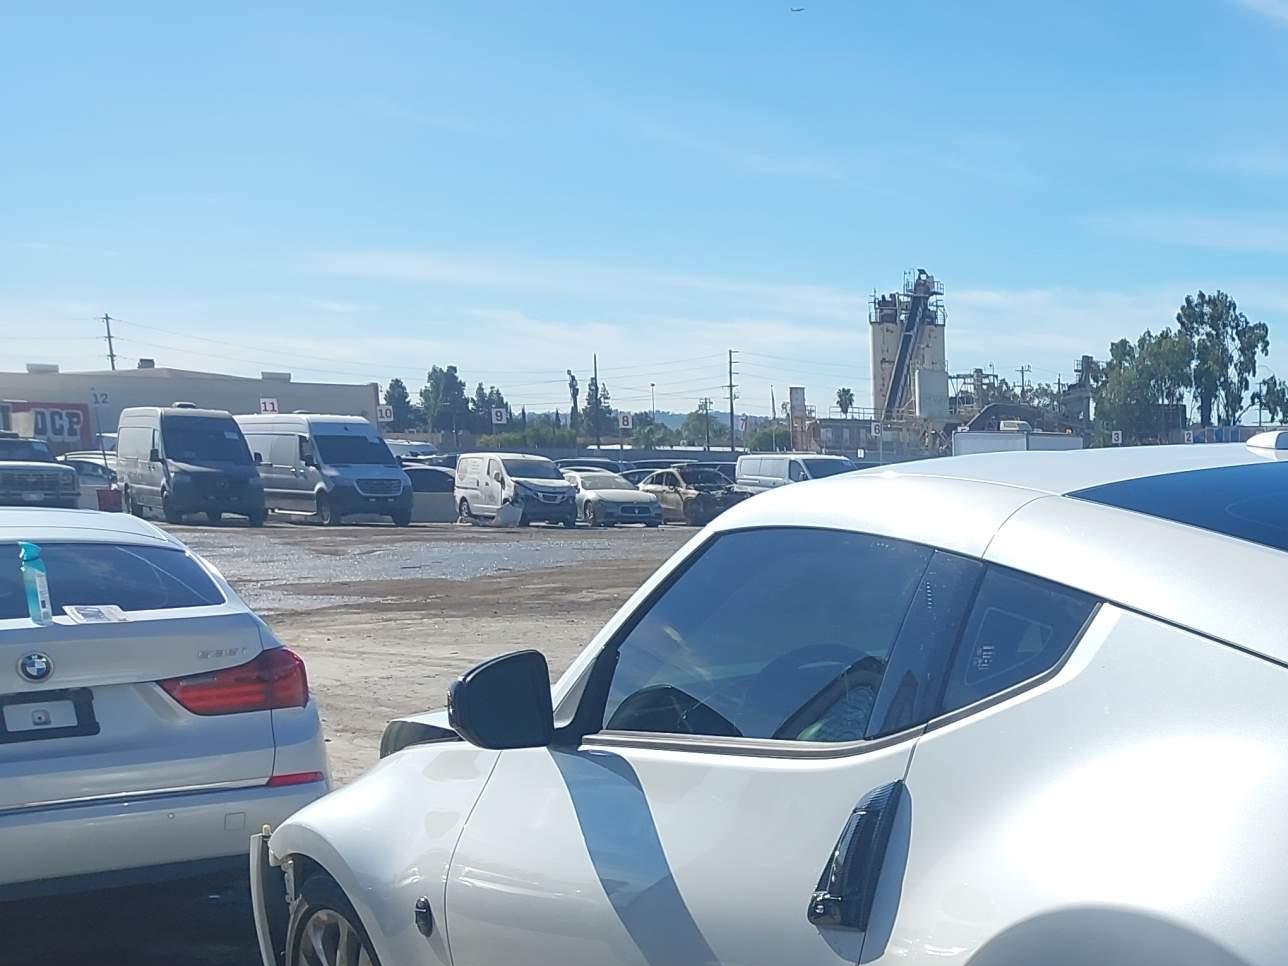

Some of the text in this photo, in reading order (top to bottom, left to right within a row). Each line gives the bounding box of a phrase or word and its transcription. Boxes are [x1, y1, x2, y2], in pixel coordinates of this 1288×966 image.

[93, 393, 109, 404] 12
[261, 401, 278, 413] 11
[378, 408, 393, 419] 10
[495, 410, 504, 422] 9
[1113, 431, 1121, 442] 3
[1186, 431, 1192, 442] 2
